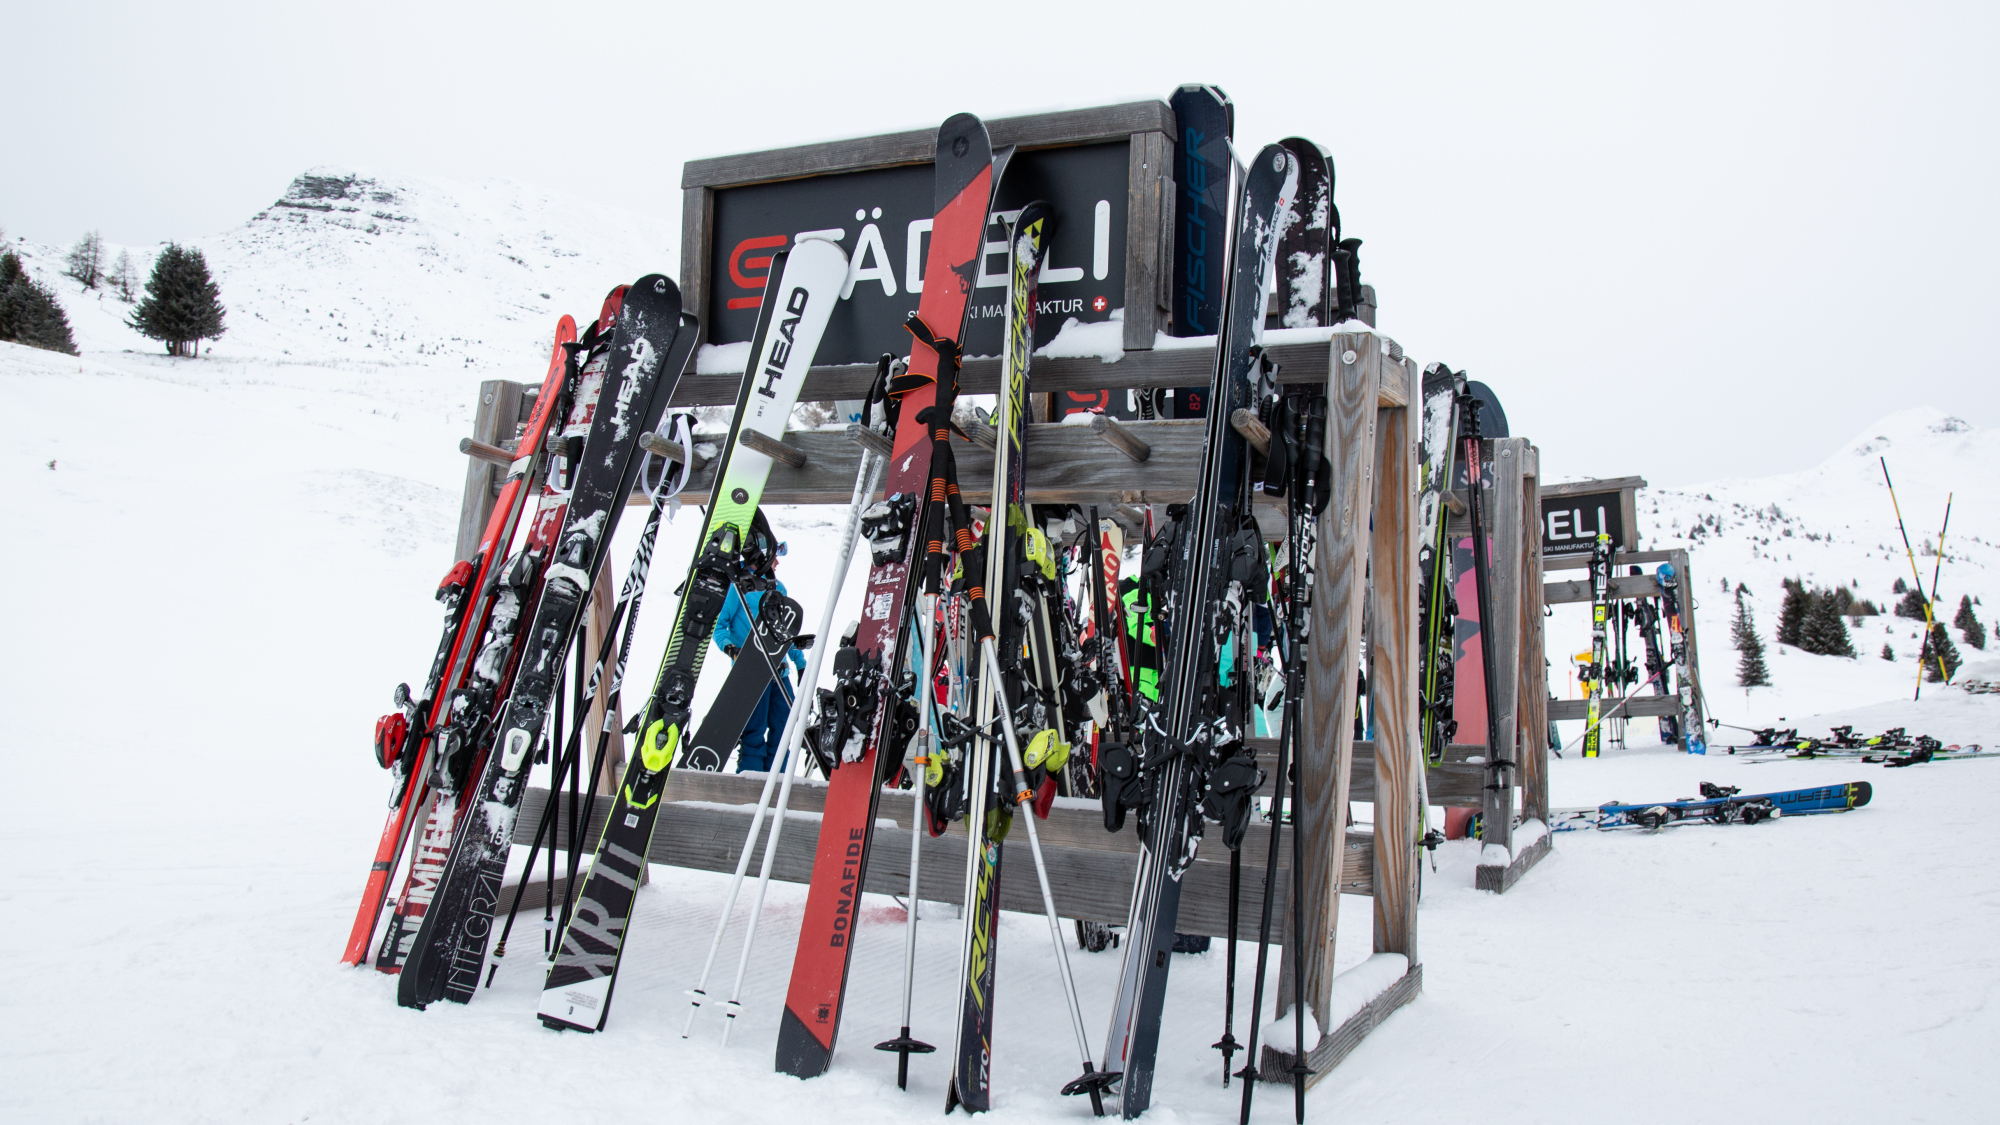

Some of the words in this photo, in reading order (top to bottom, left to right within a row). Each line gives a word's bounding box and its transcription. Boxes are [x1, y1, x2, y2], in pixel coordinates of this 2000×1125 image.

[1186, 127, 1205, 333] FISCHER
[1266, 234, 1275, 263] SWISS
[1271, 206, 1281, 235] MADE
[982, 298, 1083, 319] MAAKTUR
[758, 285, 810, 399] HEAD
[610, 336, 648, 424] HEAD
[1189, 394, 1201, 410] 82
[1541, 506, 1606, 540] ELI
[1543, 544, 1554, 552] SKI
[1104, 636, 1117, 695] ATOMIC
[1780, 787, 1846, 804] TEAM
[830, 827, 864, 948] BONAFIDE
[968, 840, 995, 1012] RC4
[979, 1048, 989, 1090] 170
